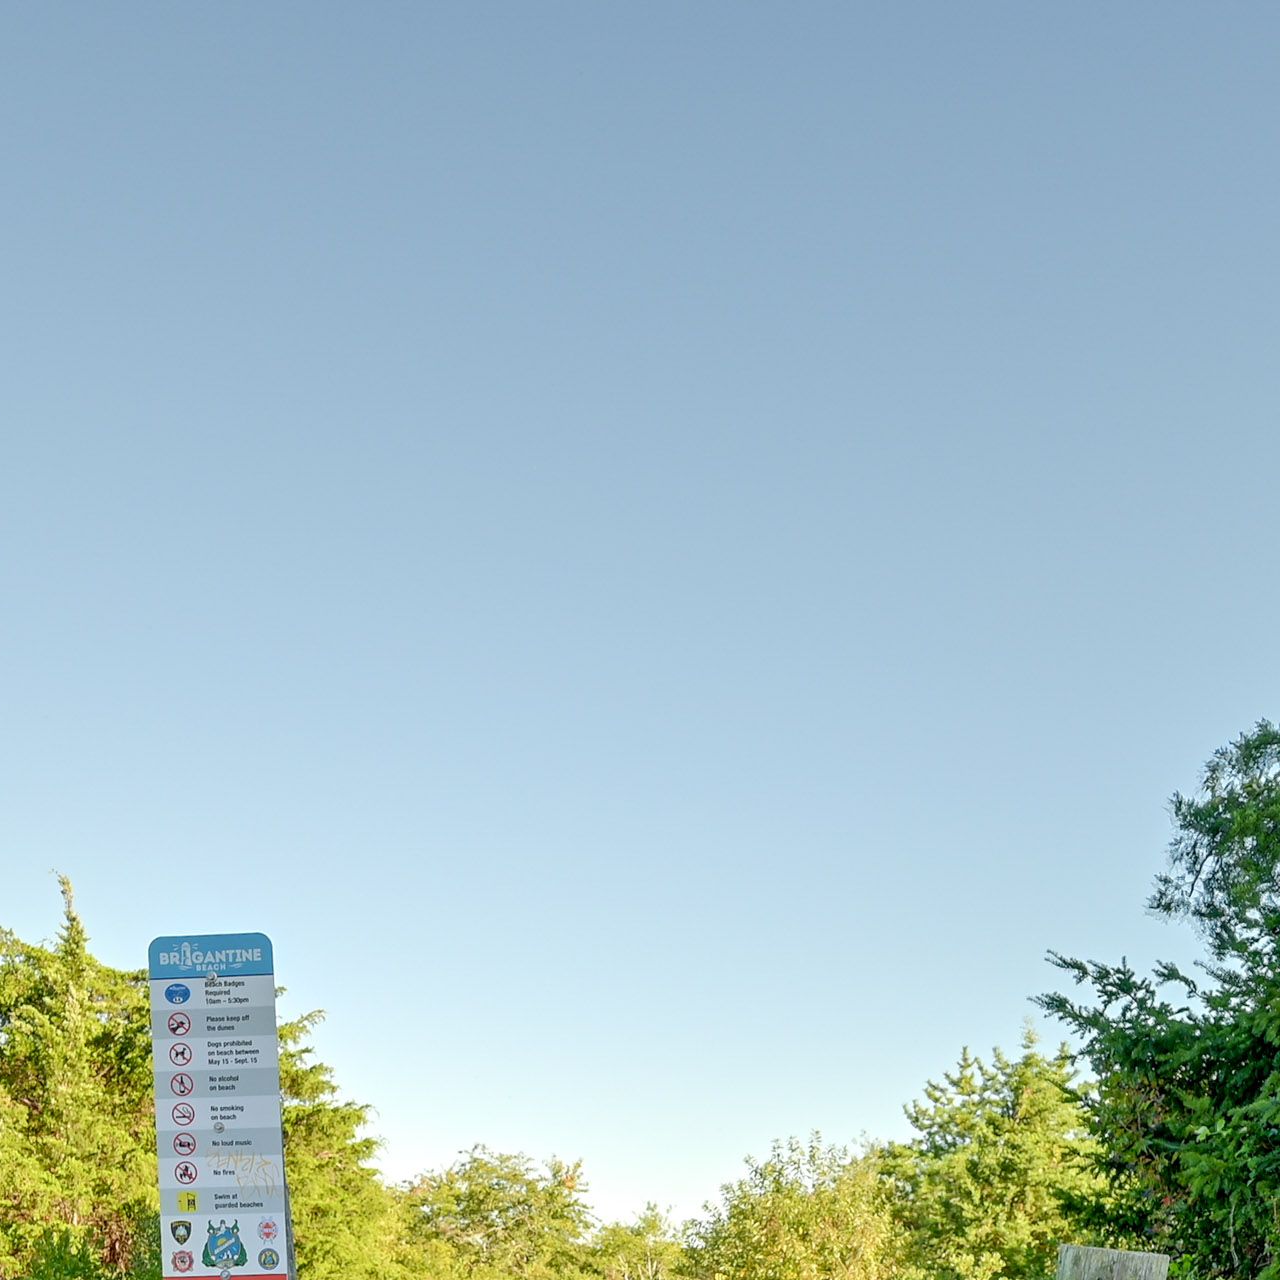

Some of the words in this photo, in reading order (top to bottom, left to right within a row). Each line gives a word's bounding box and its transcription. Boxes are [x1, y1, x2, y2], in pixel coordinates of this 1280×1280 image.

[159, 942, 262, 966] BRIGANTINE
[196, 963, 226, 971] BEACH
[223, 1040, 252, 1048] prohibited
[215, 1202, 238, 1210] guarded
